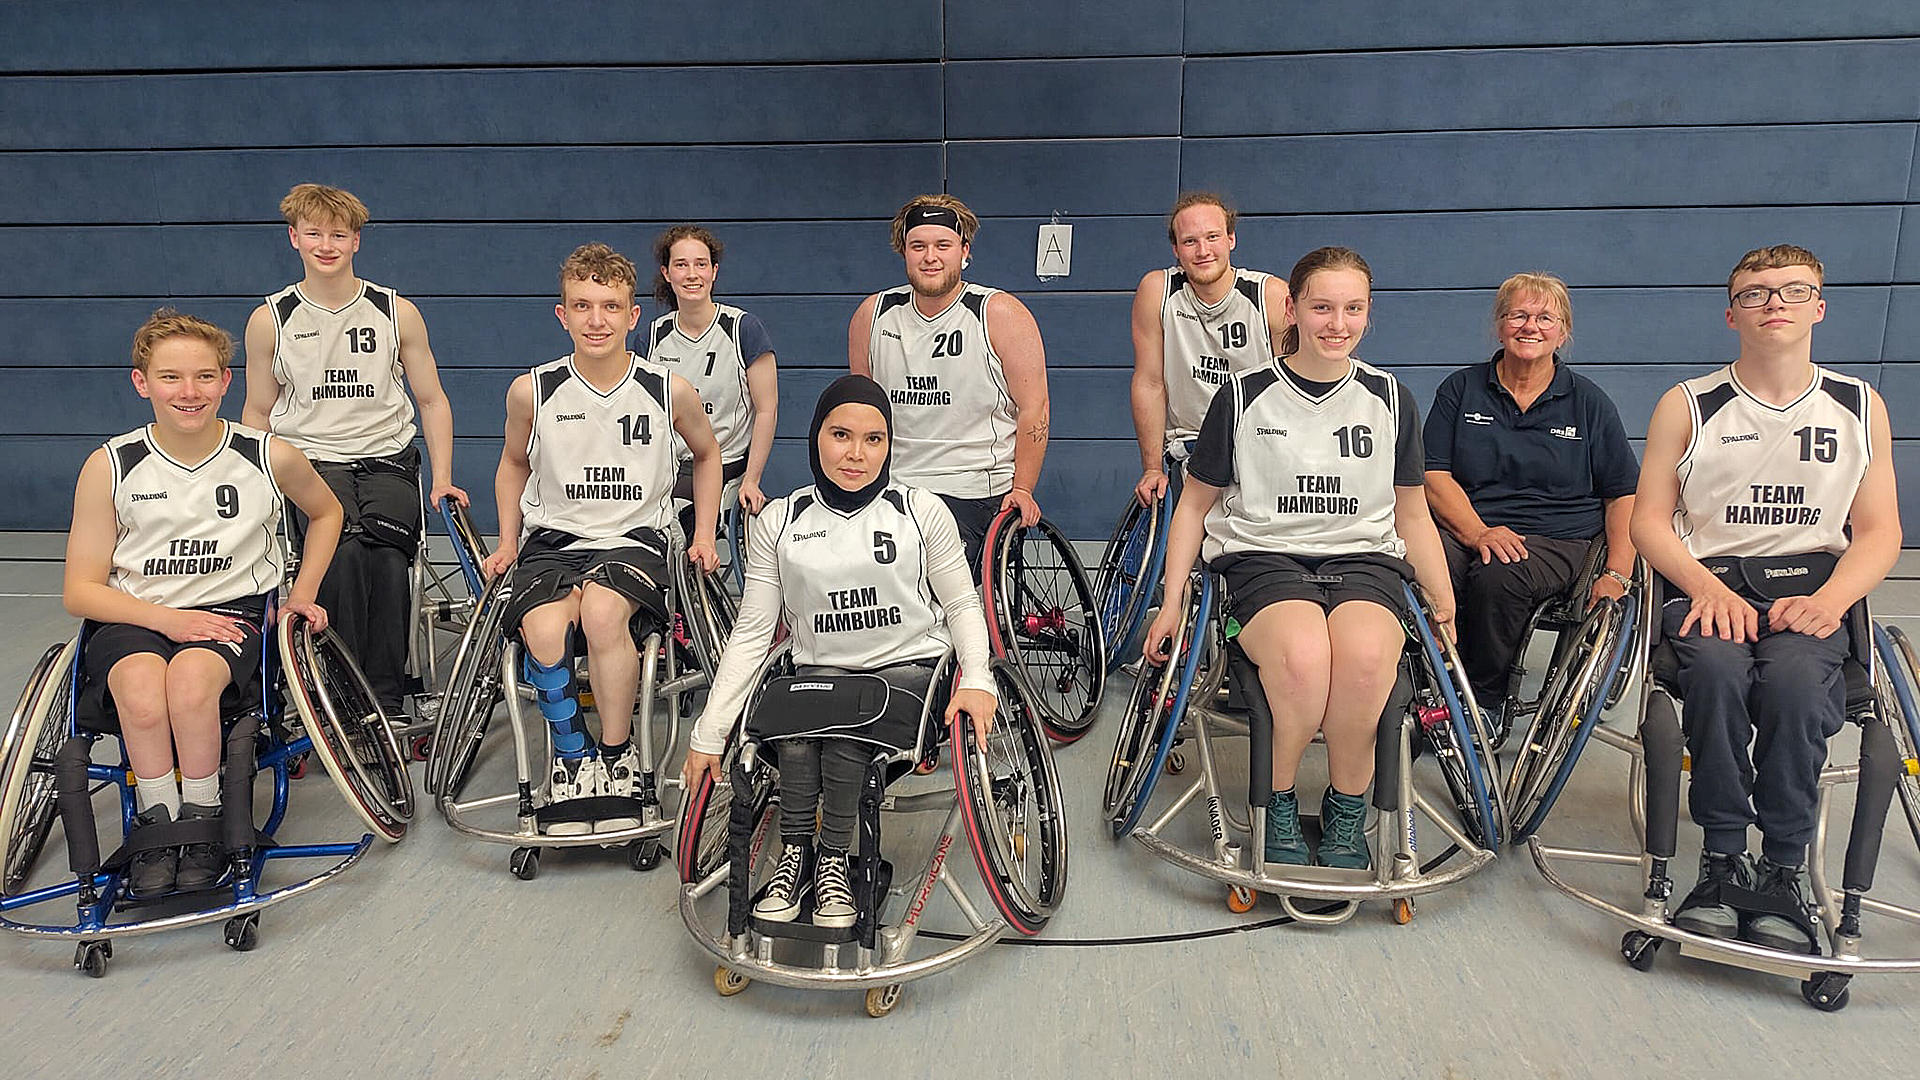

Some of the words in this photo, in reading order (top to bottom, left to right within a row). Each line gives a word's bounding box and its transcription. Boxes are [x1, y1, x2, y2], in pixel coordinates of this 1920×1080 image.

[1042, 233, 1064, 267] A
[345, 327, 376, 353] 13
[931, 329, 963, 358] 20
[1217, 321, 1247, 349] 19
[1200, 355, 1230, 372] TEAM
[324, 369, 358, 383] TEAM
[905, 376, 938, 390] TEAM
[890, 390, 951, 405] HAMBURG
[555, 412, 586, 422] SPALDING
[617, 414, 652, 445] 14
[1256, 427, 1288, 437] SPALDING
[1721, 433, 1759, 445] SPALDING
[1333, 424, 1373, 459] 16
[1793, 426, 1838, 463] 15
[584, 466, 625, 482] TEAM
[565, 484, 643, 500] HAMBURG
[1296, 475, 1341, 493] TEAM
[131, 490, 168, 502] SPALDING
[215, 484, 239, 518] 9
[1751, 485, 1804, 504] TEAM
[1277, 496, 1359, 515] HAMBURG
[1725, 505, 1821, 525] HAMBURG
[792, 530, 827, 542] SPALDING
[169, 539, 218, 556] TEAM
[873, 530, 897, 564] 5
[143, 556, 232, 576] HAMBURG
[828, 587, 878, 610] TEAM
[814, 606, 902, 633] HAMBURG
